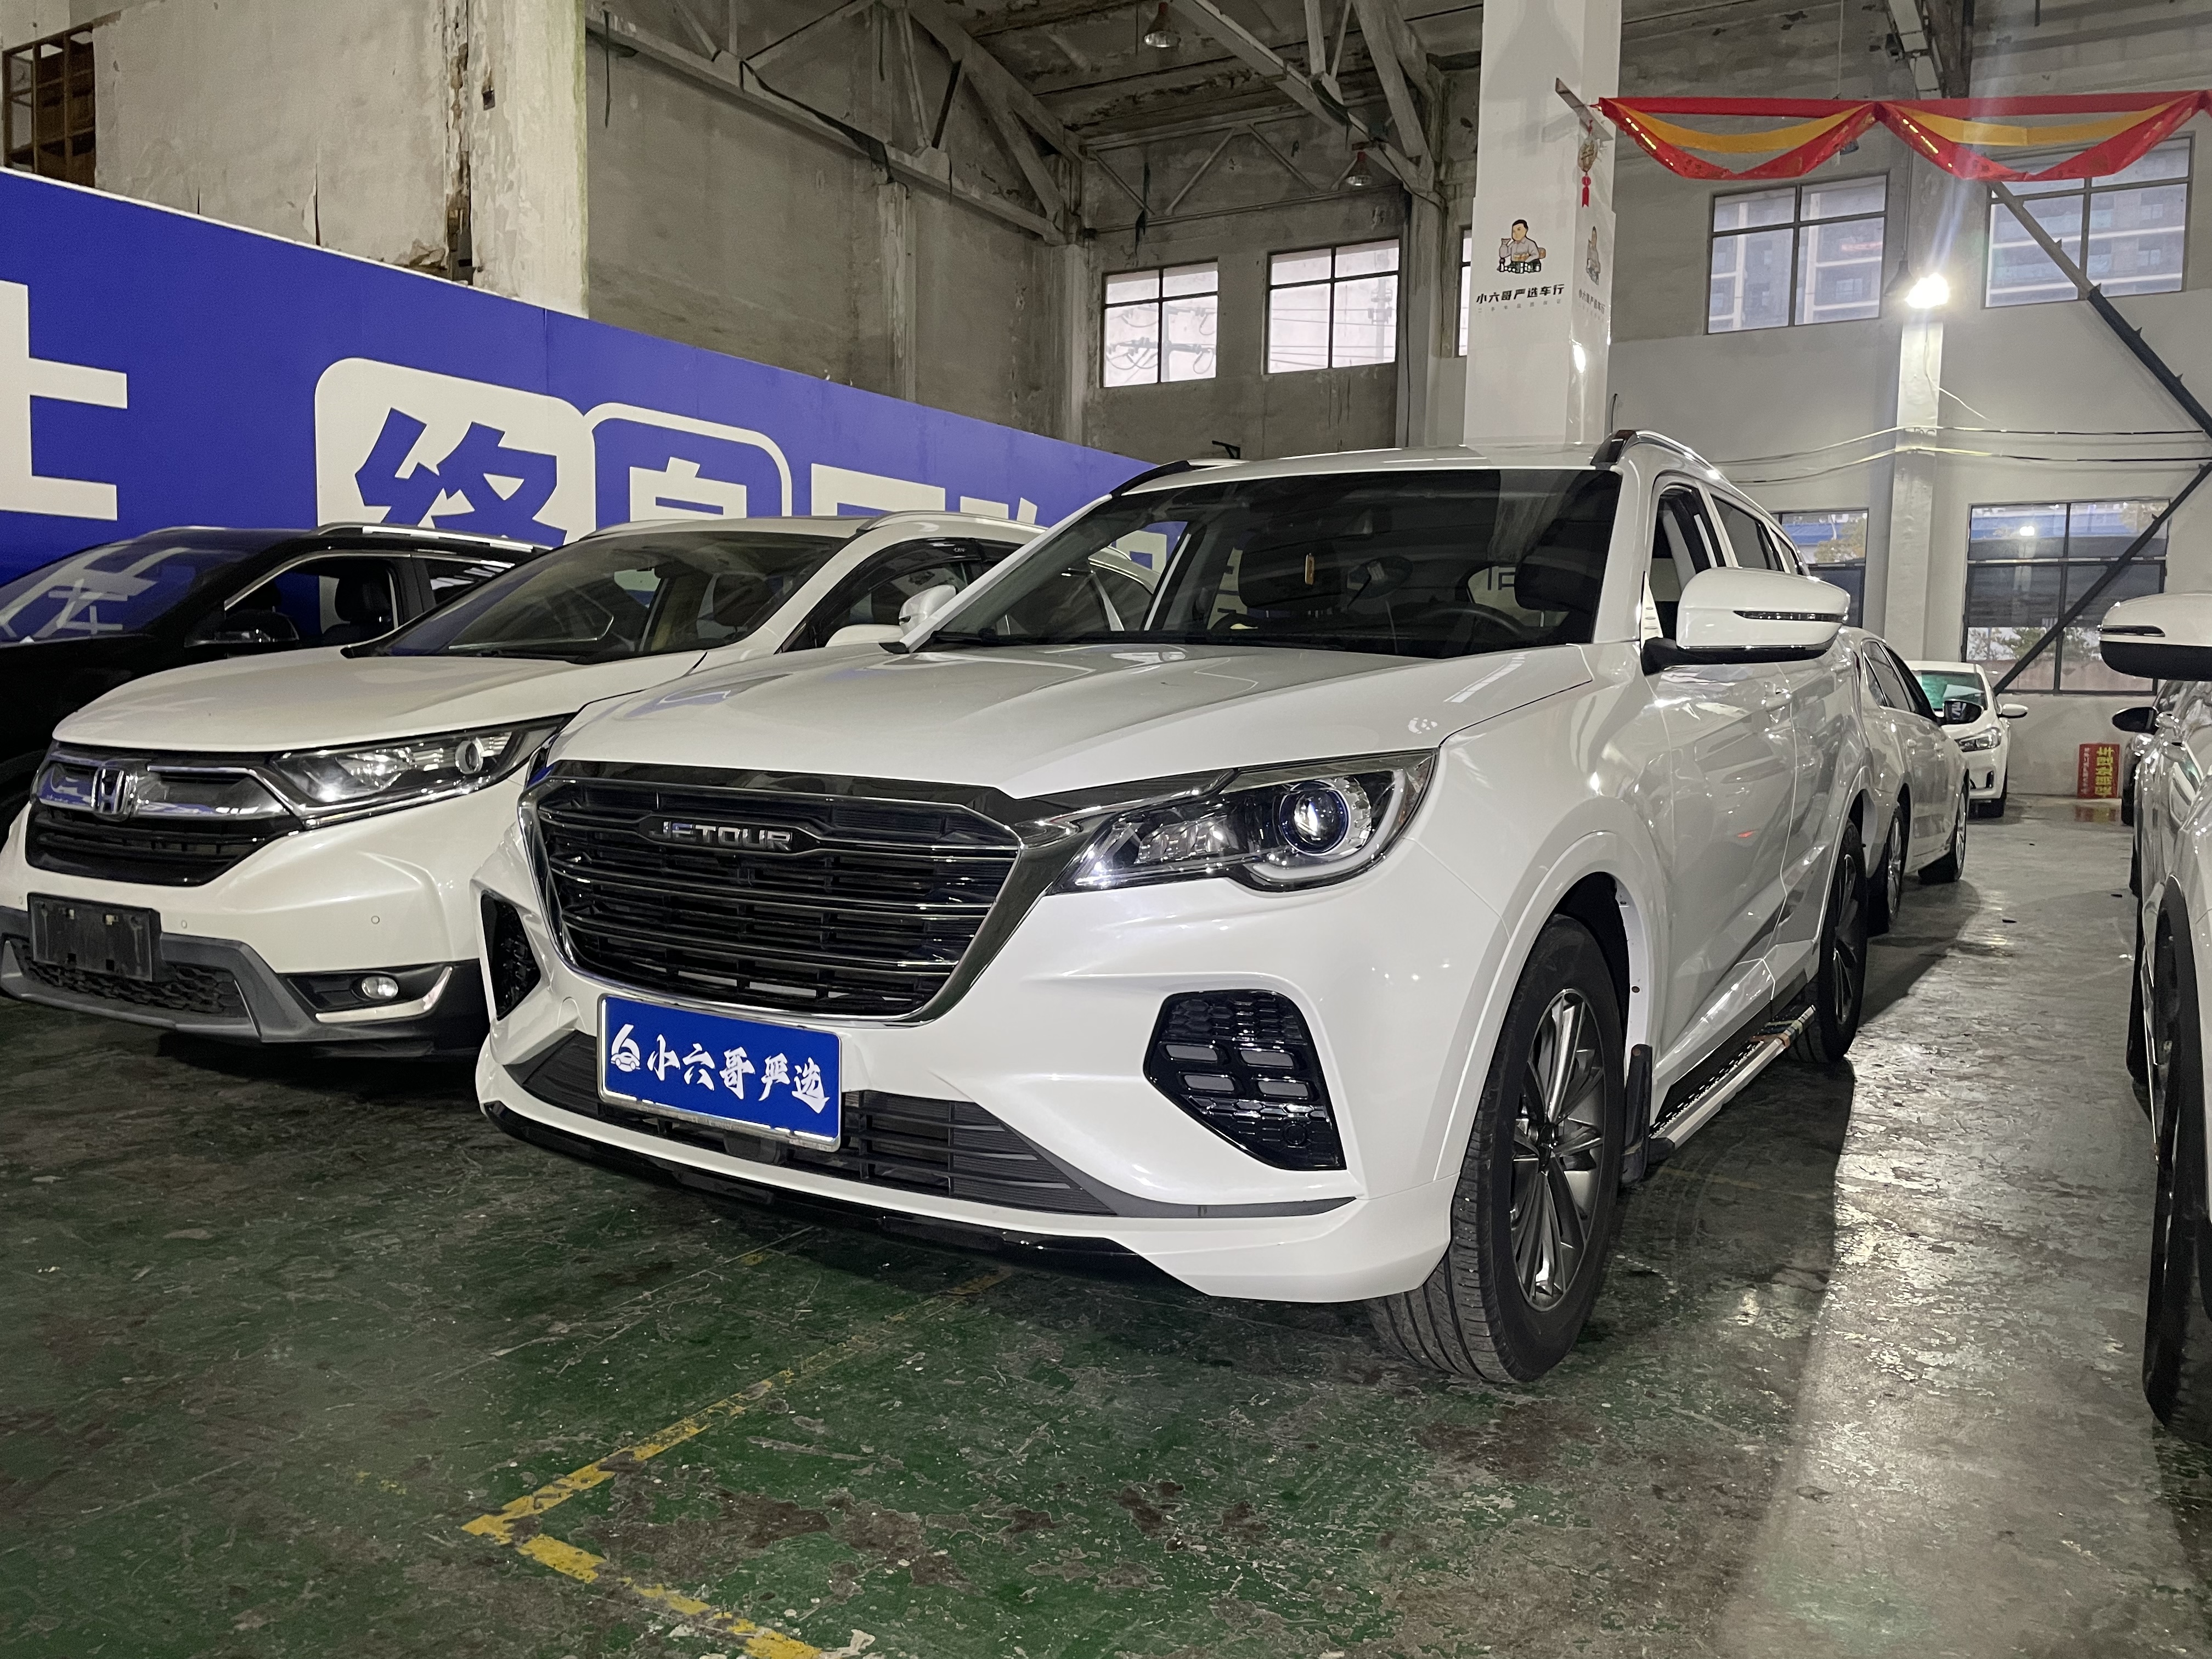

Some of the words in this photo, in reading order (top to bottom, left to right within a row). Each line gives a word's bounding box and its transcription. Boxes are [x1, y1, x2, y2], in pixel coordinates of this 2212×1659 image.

[1476, 284, 1565, 304] 小六哥严选车行
[648, 821, 793, 851] JETOUR
[647, 1034, 830, 1114] 小六哥严选
